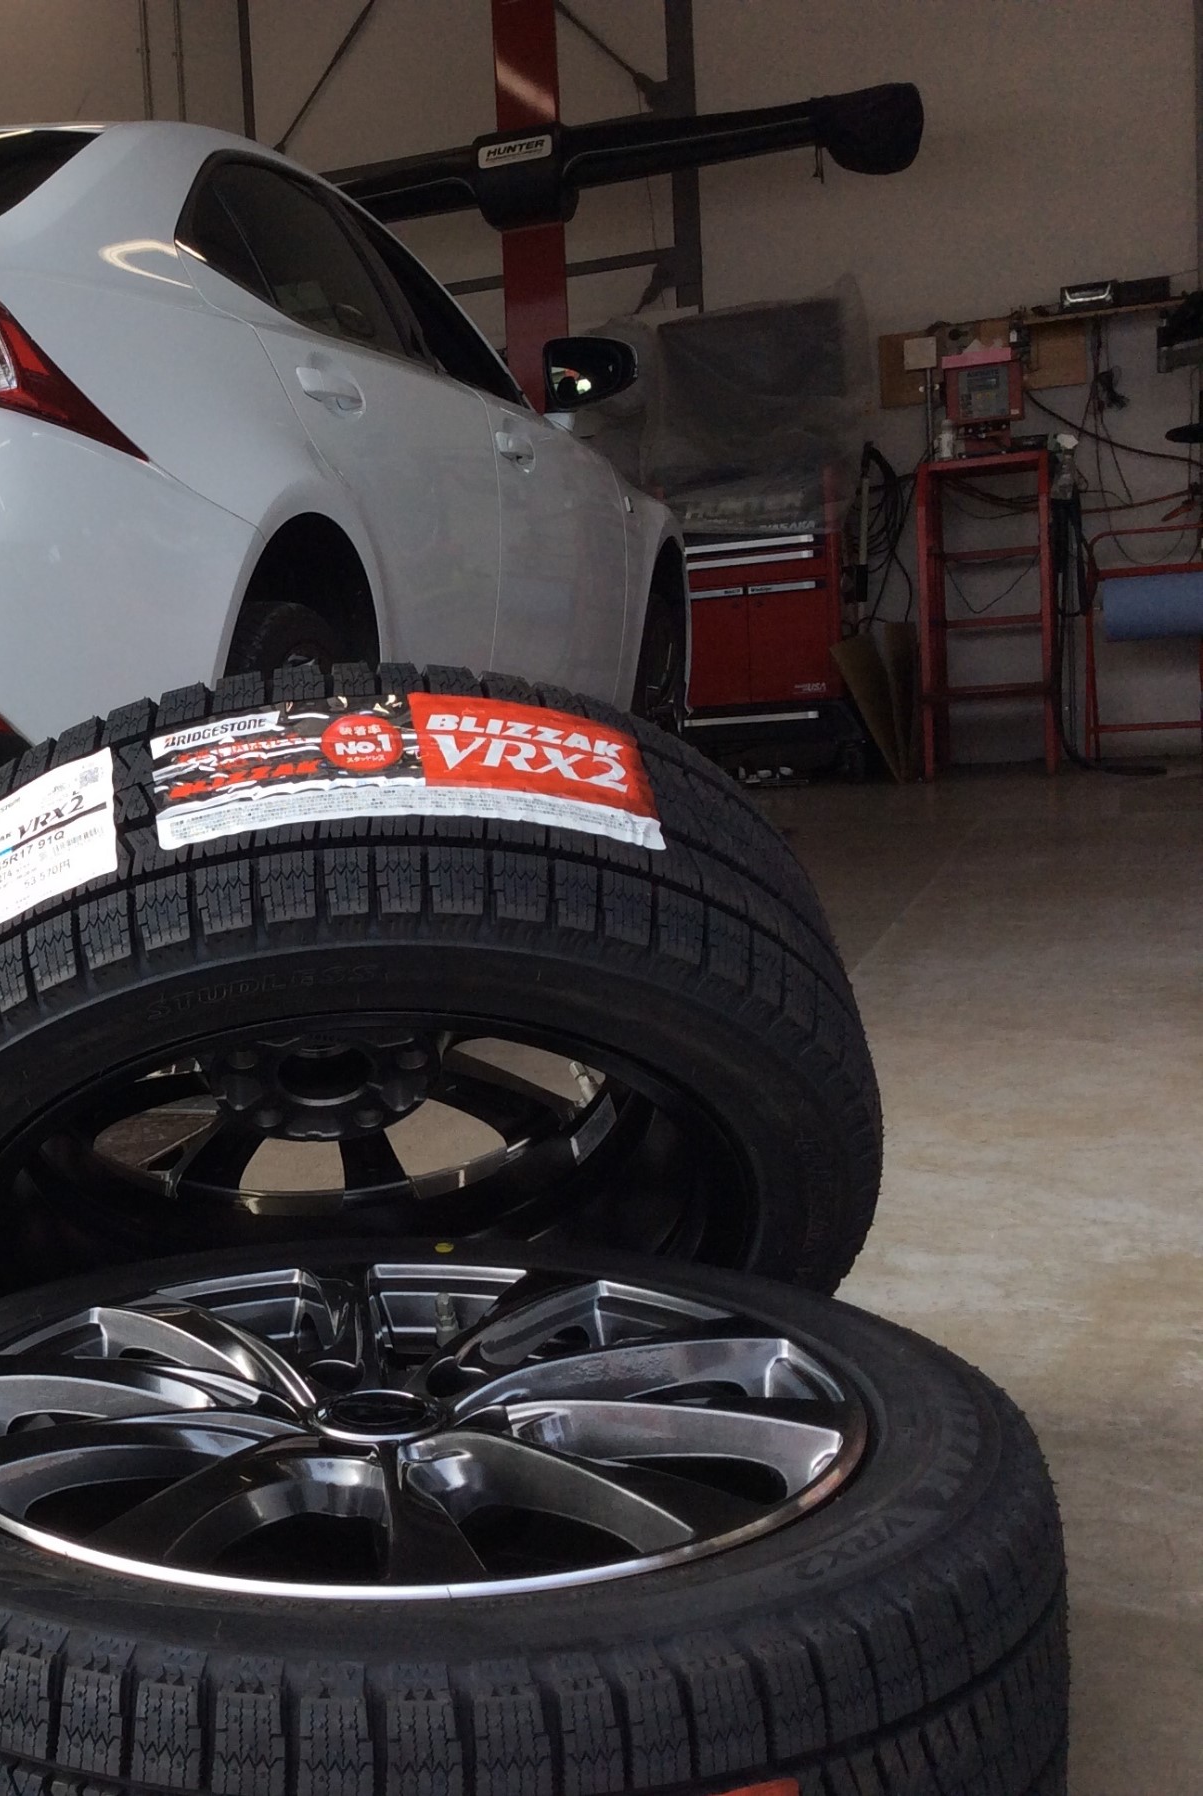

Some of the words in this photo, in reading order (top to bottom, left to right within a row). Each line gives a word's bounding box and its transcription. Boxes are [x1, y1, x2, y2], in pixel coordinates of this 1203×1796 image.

[485, 139, 545, 158] HUNTER
[163, 717, 266, 749] BRIDGESTONE
[425, 713, 624, 760] BLIZZAK
[429, 733, 629, 793] VRX2
[18, 794, 85, 840] VRX2
[37, 830, 66, 850] 91Q
[147, 964, 380, 1019] STUDLESS
[796, 1515, 916, 1580] VRX2
